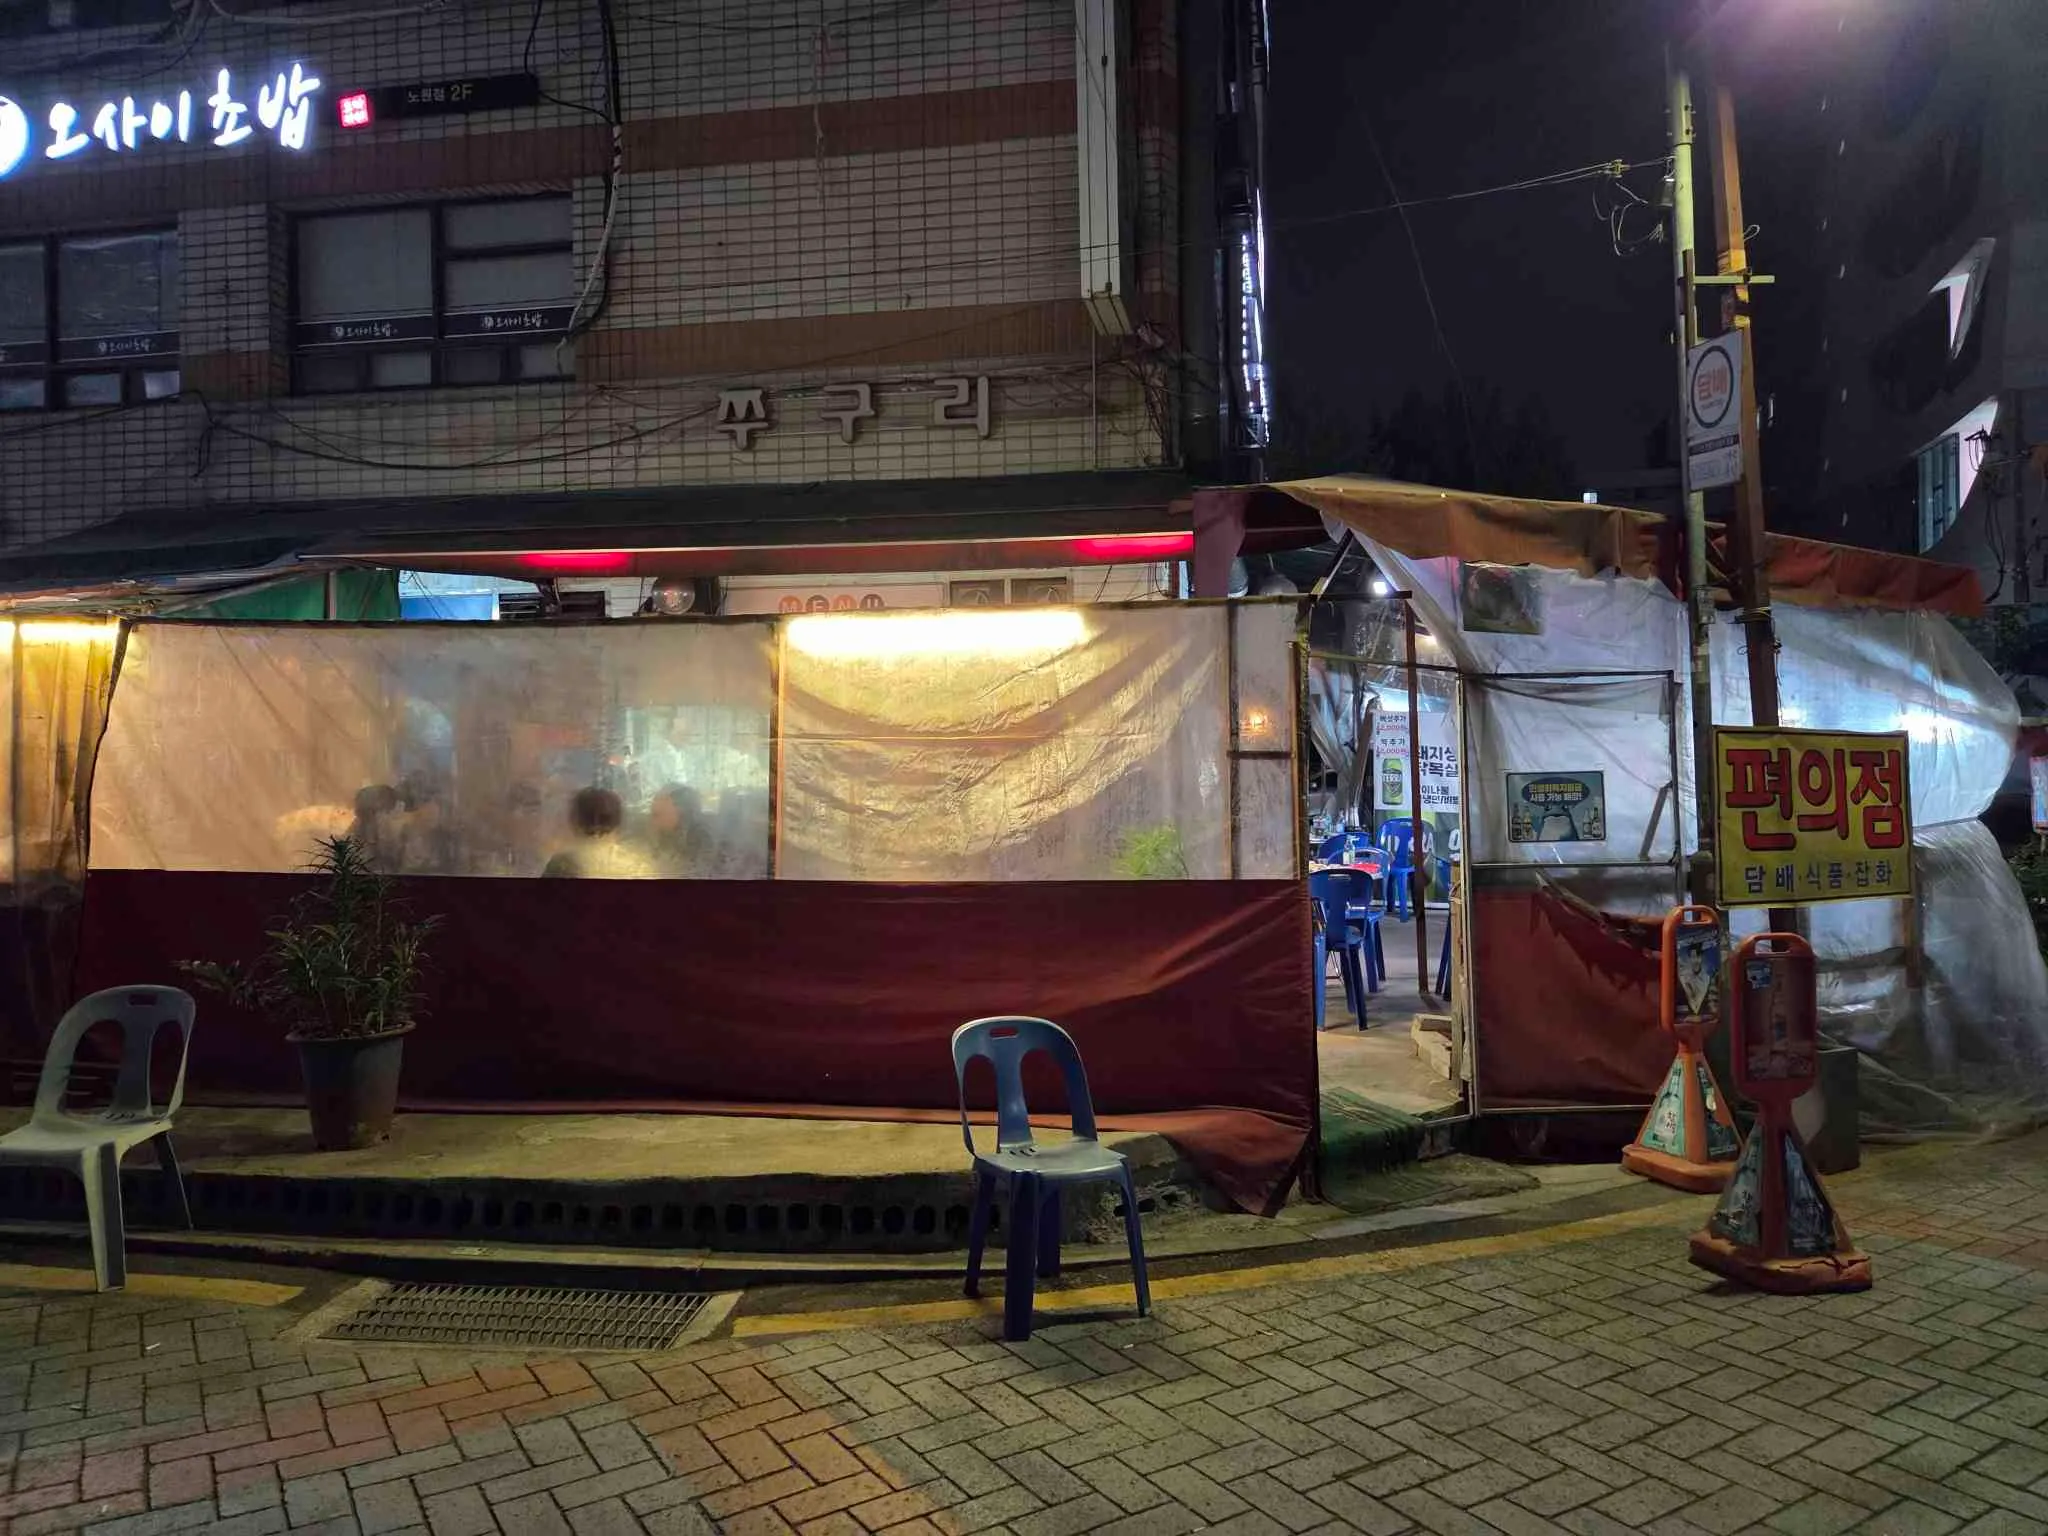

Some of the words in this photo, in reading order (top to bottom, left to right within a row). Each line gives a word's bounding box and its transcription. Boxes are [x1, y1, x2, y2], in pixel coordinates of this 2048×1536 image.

[407, 87, 445, 103] 노원점
[450, 83, 474, 101] 2F
[715, 375, 990, 451] 쭈구리
[1725, 747, 1905, 851] 편의점
